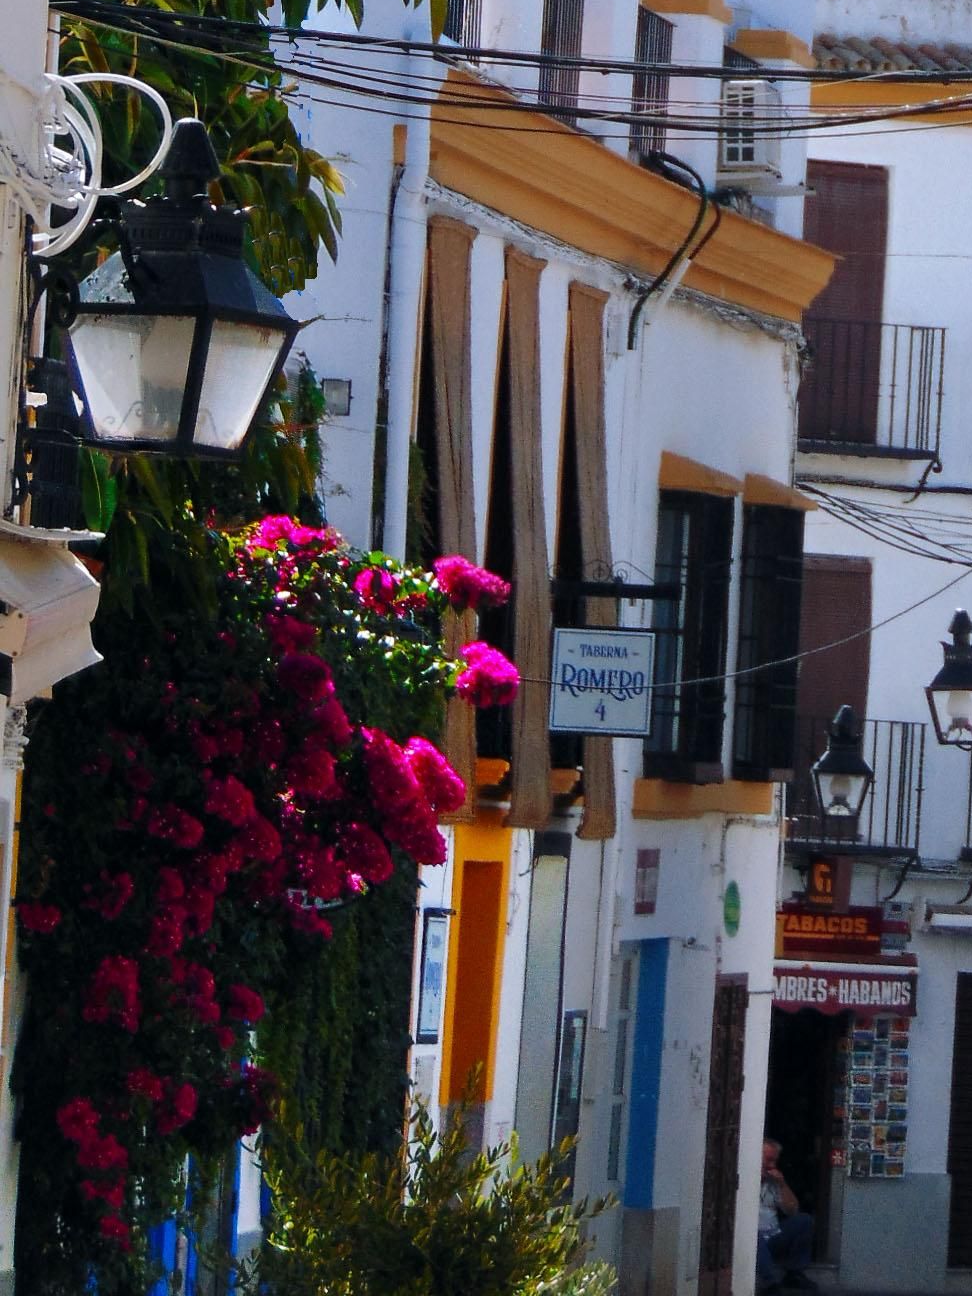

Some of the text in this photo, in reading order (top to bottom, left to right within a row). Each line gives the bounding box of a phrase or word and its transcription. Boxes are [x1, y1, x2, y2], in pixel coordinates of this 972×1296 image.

[579, 643, 629, 658] TABERNA
[560, 663, 644, 701] ROMERO
[594, 704, 606, 722] 4
[777, 914, 868, 934] TABACOS
[838, 979, 911, 1006] HABANOS
